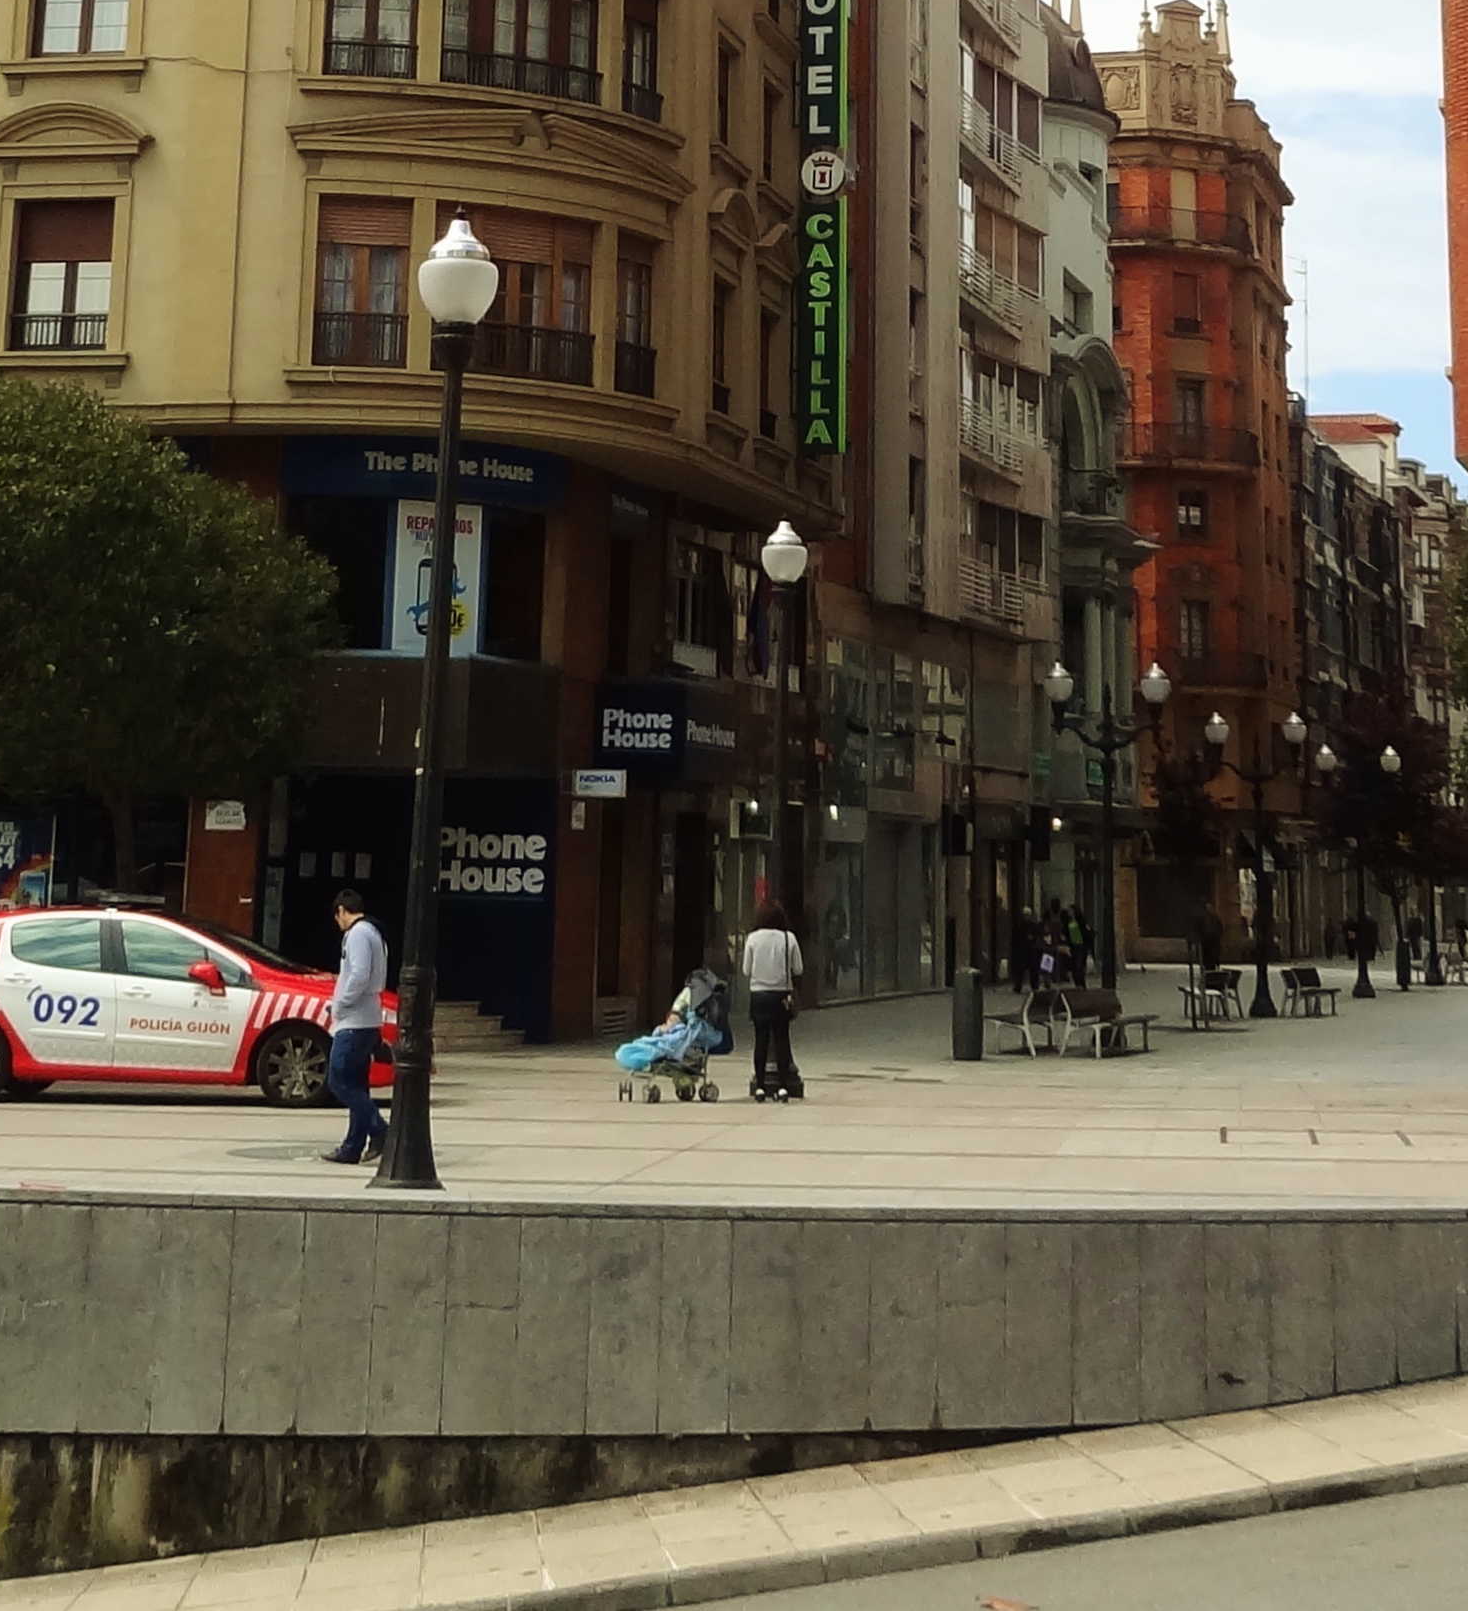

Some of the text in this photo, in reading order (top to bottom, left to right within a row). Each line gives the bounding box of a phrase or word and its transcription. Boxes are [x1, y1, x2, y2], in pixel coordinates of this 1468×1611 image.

[805, 212, 835, 446] CASTILLA
[364, 451, 406, 471] The
[483, 457, 534, 482] House
[602, 708, 673, 729] Phone
[602, 728, 672, 749] House
[579, 774, 616, 784] NOKIA
[440, 826, 547, 861] Phone
[438, 859, 545, 894] House
[33, 992, 101, 1027] 092
[129, 1016, 231, 1035] POLICÍA GIJÓN
